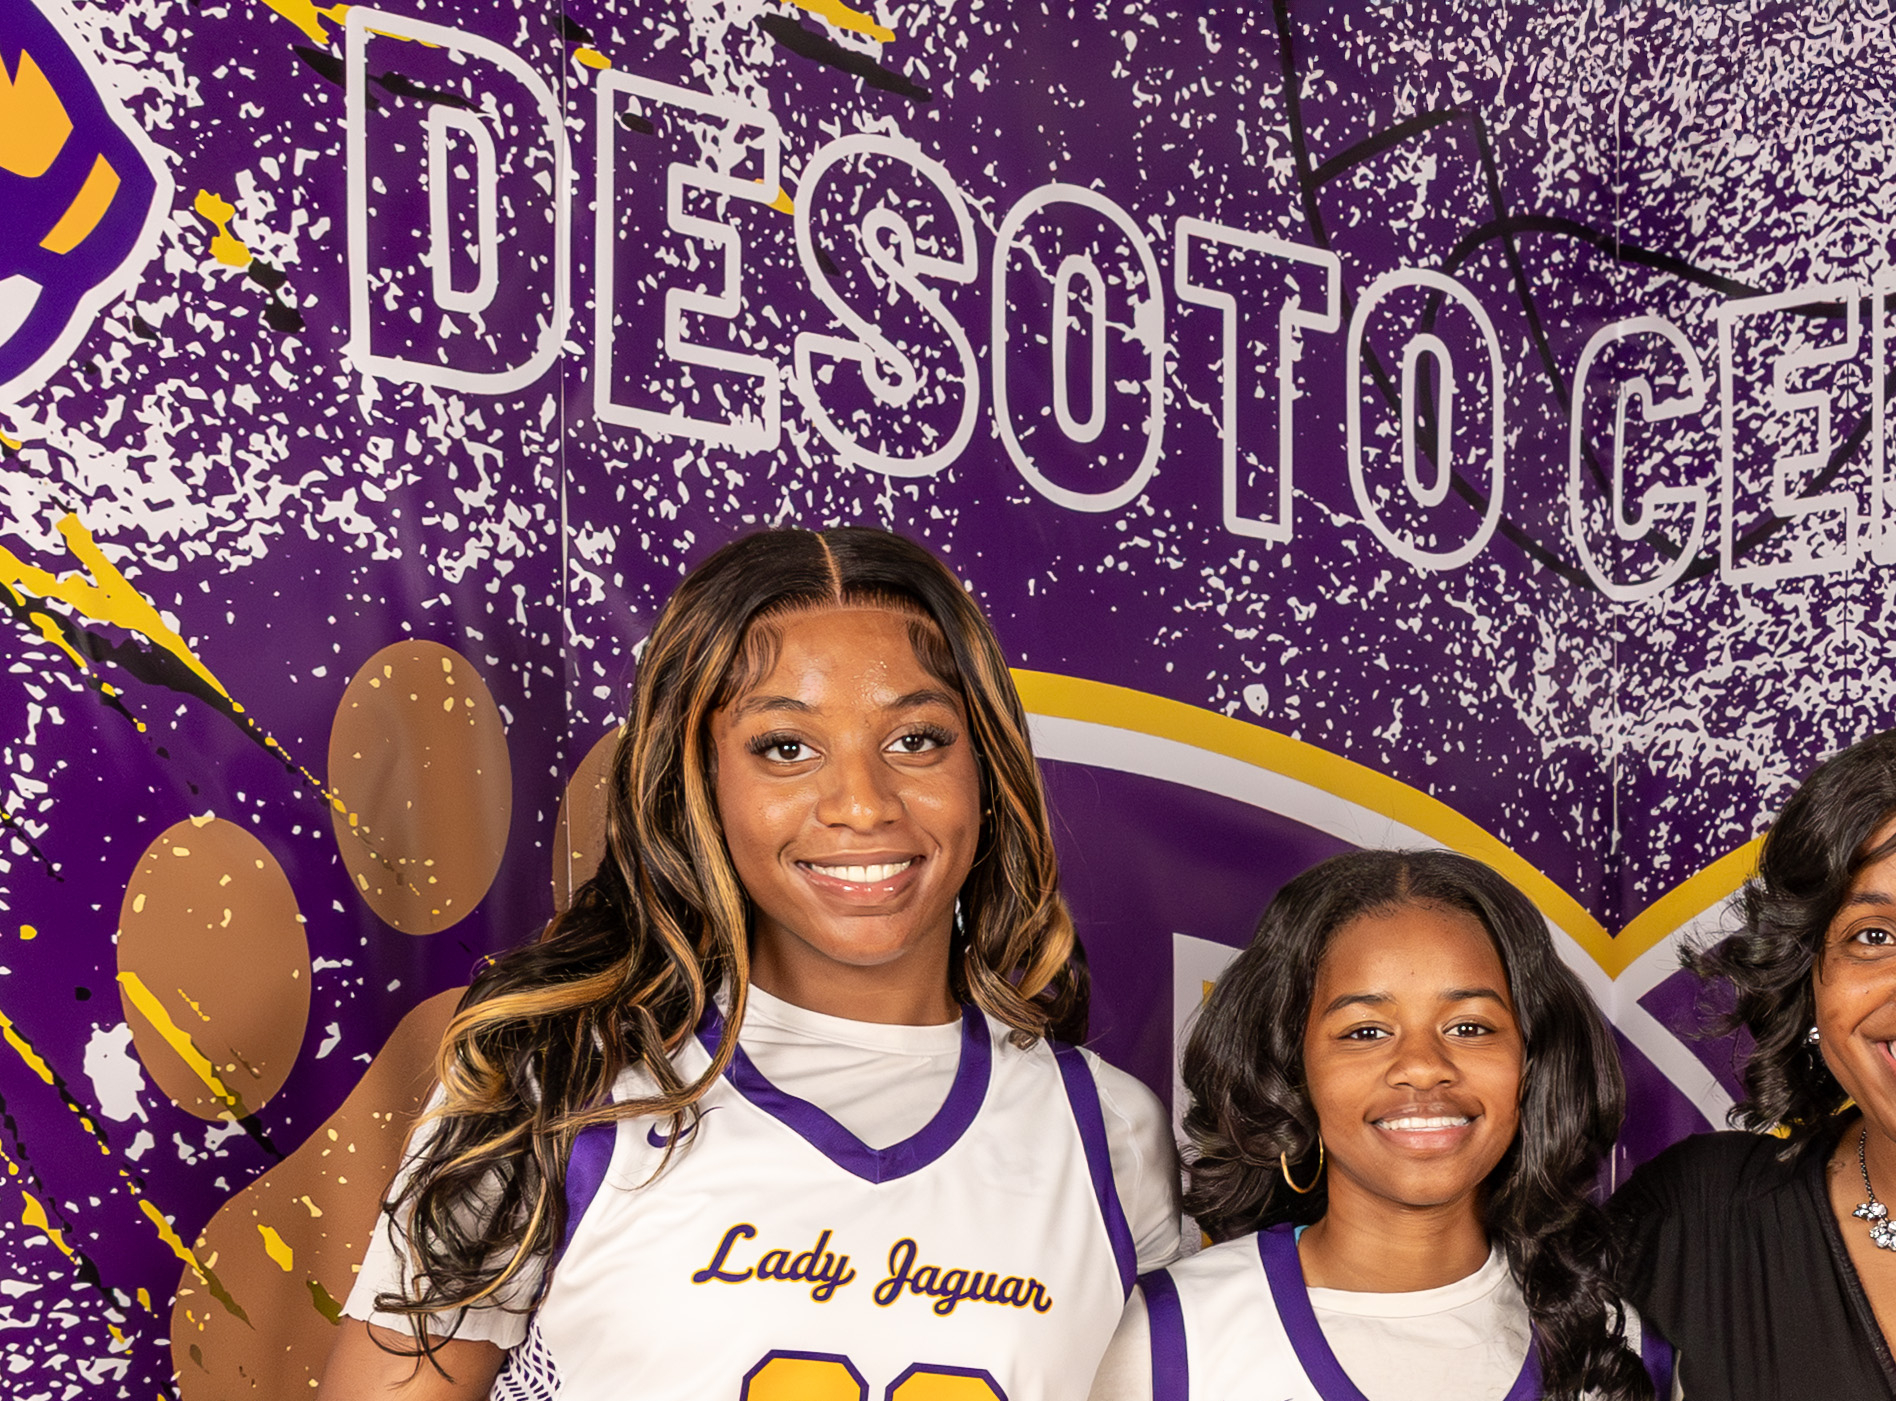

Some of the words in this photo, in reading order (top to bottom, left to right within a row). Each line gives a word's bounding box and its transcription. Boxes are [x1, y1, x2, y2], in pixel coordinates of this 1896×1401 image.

[345, 6, 1505, 571] DESOTO
[691, 1222, 857, 1304] Lady
[873, 1237, 1053, 1317] Jaguar
